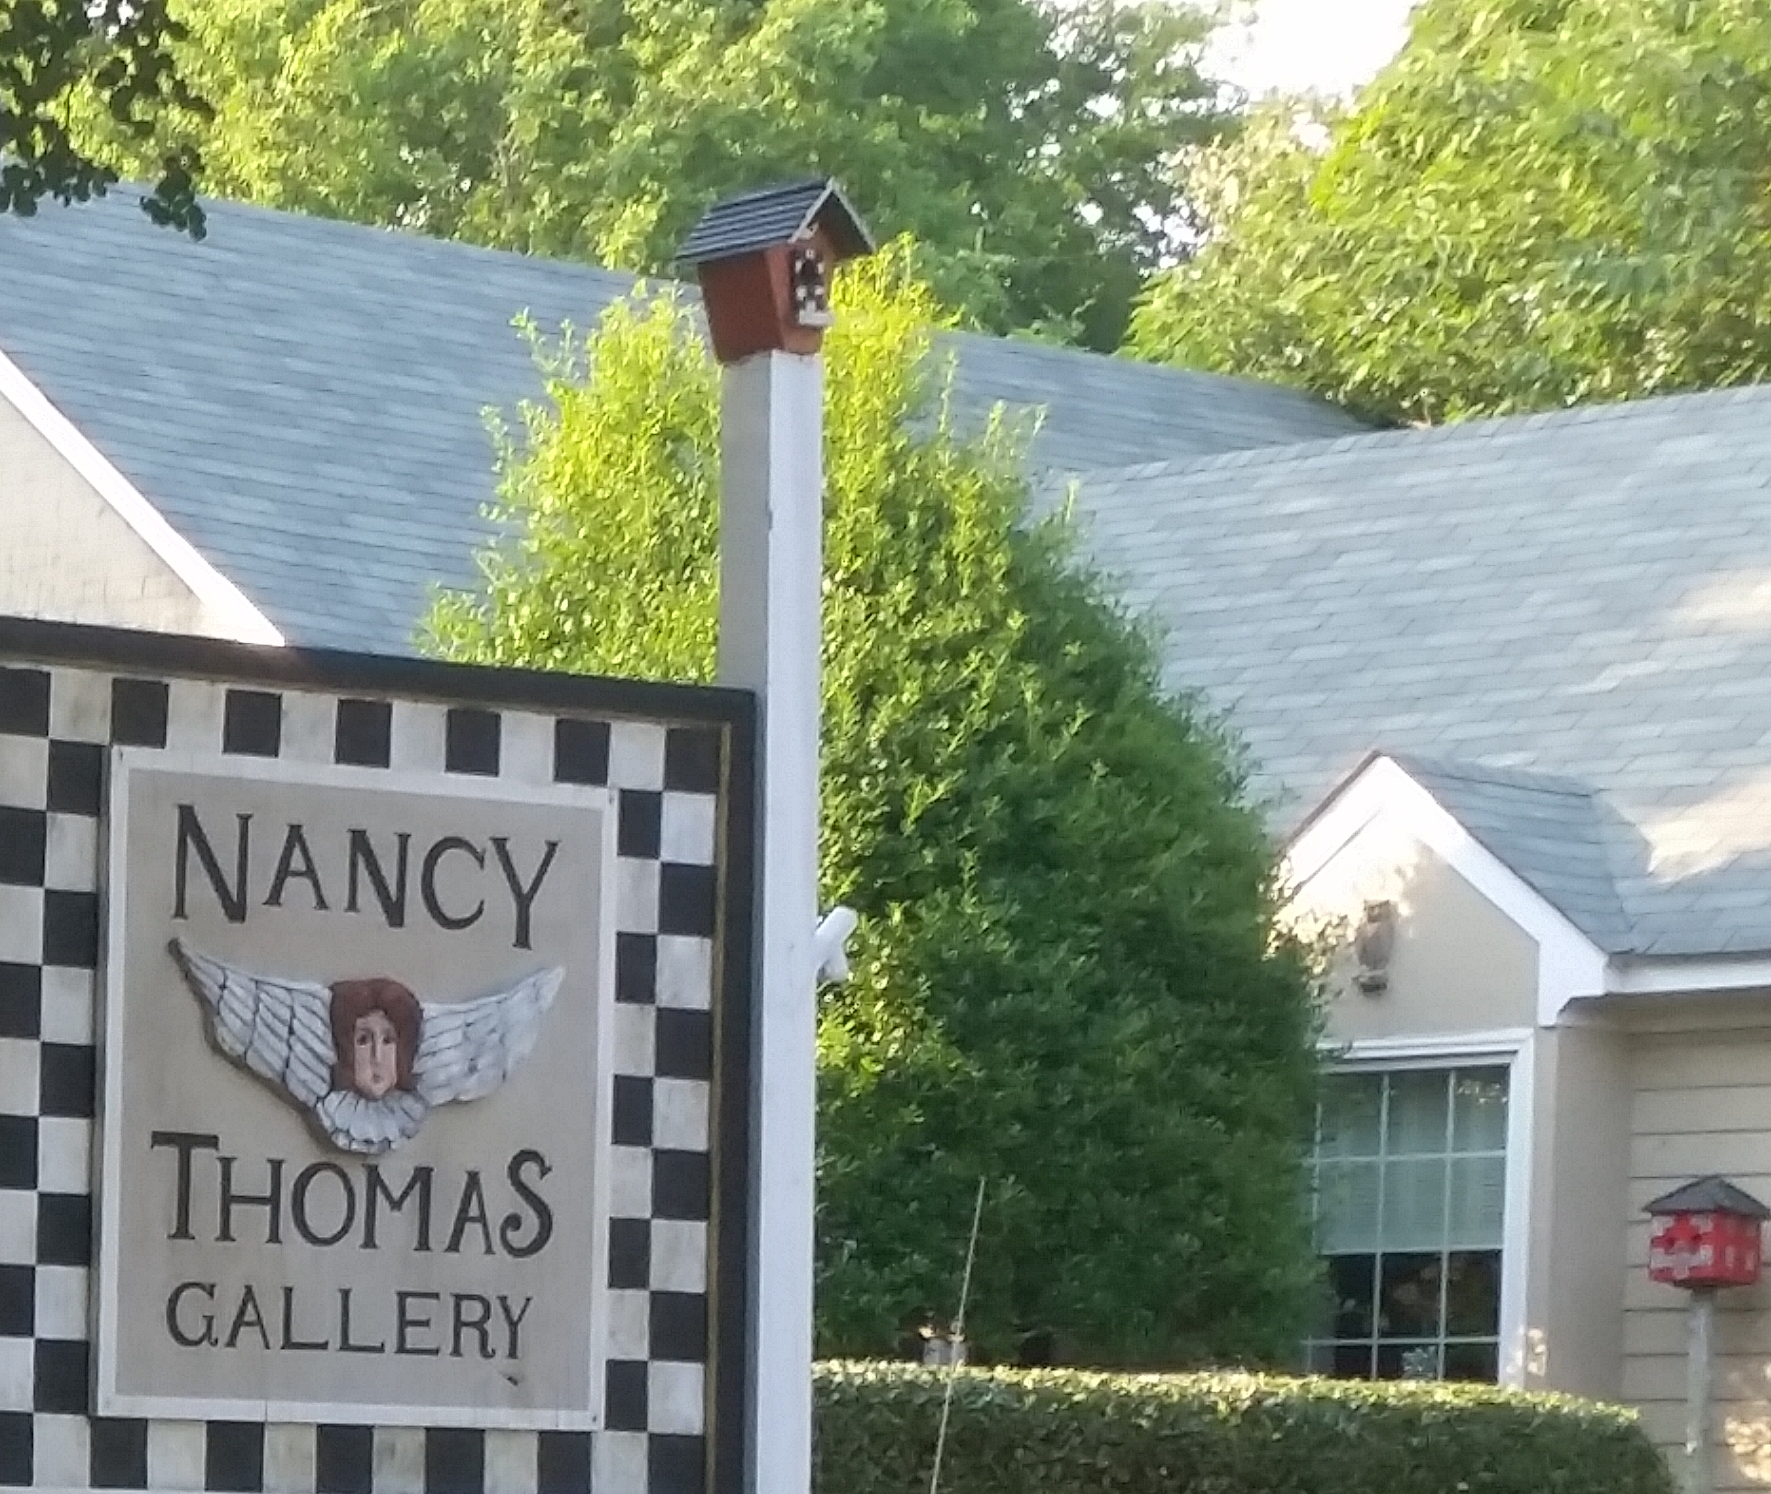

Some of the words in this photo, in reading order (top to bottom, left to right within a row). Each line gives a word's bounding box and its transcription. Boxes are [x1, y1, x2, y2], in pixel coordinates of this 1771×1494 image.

[169, 804, 559, 950] NANCY
[150, 1130, 554, 1259] THOMAS
[165, 1281, 533, 1360] GALLERY
